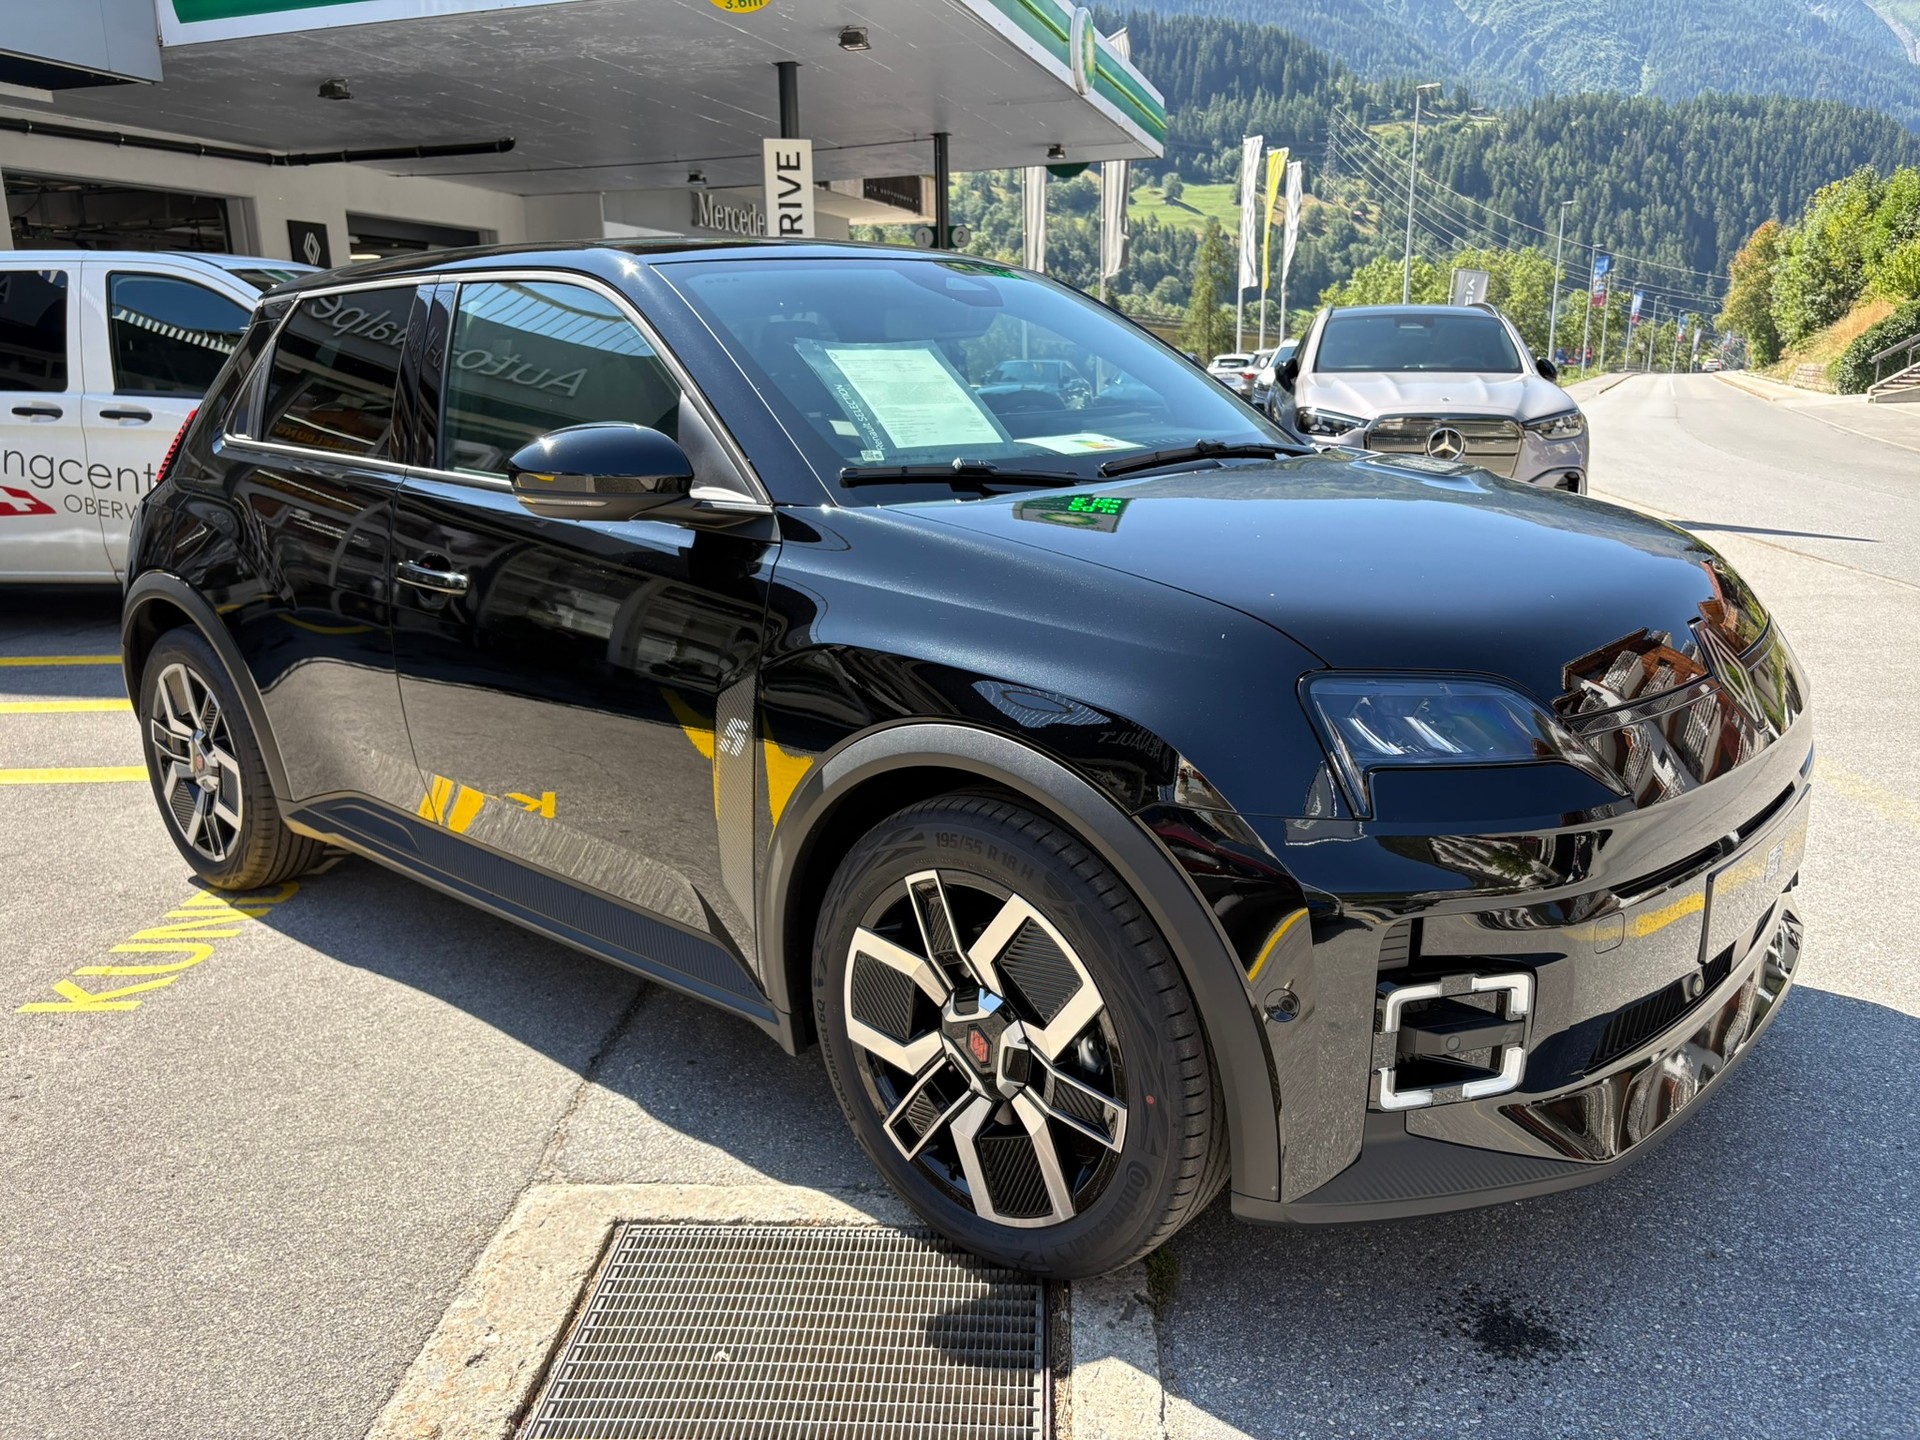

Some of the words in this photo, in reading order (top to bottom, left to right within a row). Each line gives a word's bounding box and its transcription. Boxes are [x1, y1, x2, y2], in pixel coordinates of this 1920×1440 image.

[776, 151, 803, 236] RIVE
[921, 232, 926, 243] 1
[957, 231, 964, 242] 2
[934, 831, 983, 855] 195/55
[987, 844, 998, 861] R
[1001, 851, 1018, 870] 18
[820, 1028, 857, 1122] EcoContact
